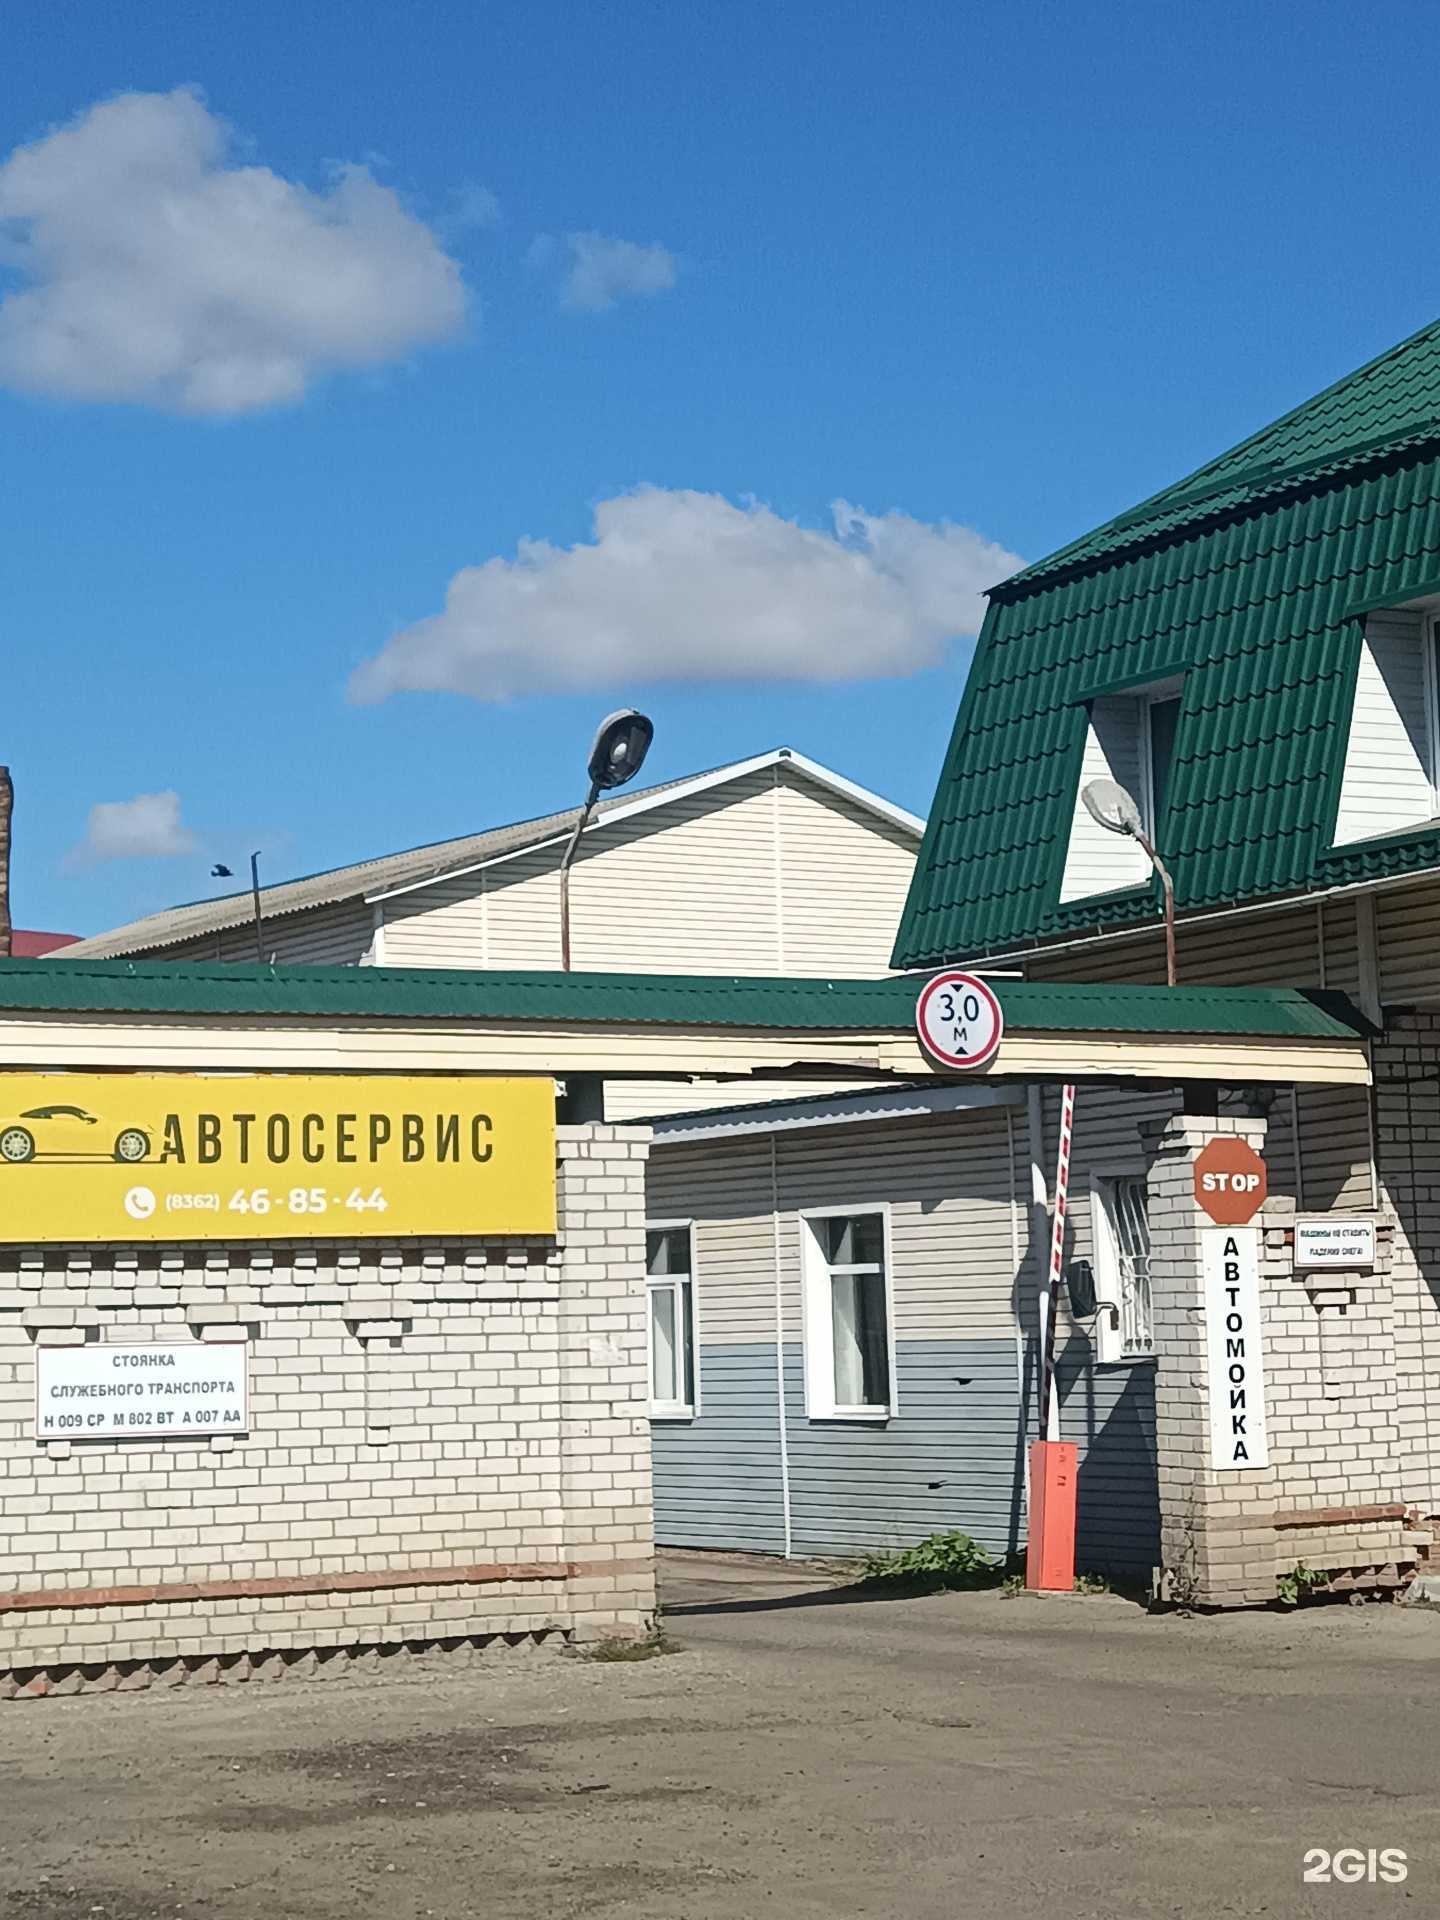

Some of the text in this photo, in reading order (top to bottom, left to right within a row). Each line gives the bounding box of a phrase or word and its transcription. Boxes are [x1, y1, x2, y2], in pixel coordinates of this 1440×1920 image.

[940, 994, 979, 1023] 3,0
[163, 1113, 493, 1164] АВТОСЕРВИС
[1202, 1173, 1260, 1192] STOP
[165, 1194, 220, 1211] (8362)
[1223, 1236, 1248, 1461] АВТОМОЙКА
[112, 1355, 175, 1367] СТОЯНКА
[51, 1381, 235, 1398] СЛУЖЕБНОГО ТРАНСПОРТА
